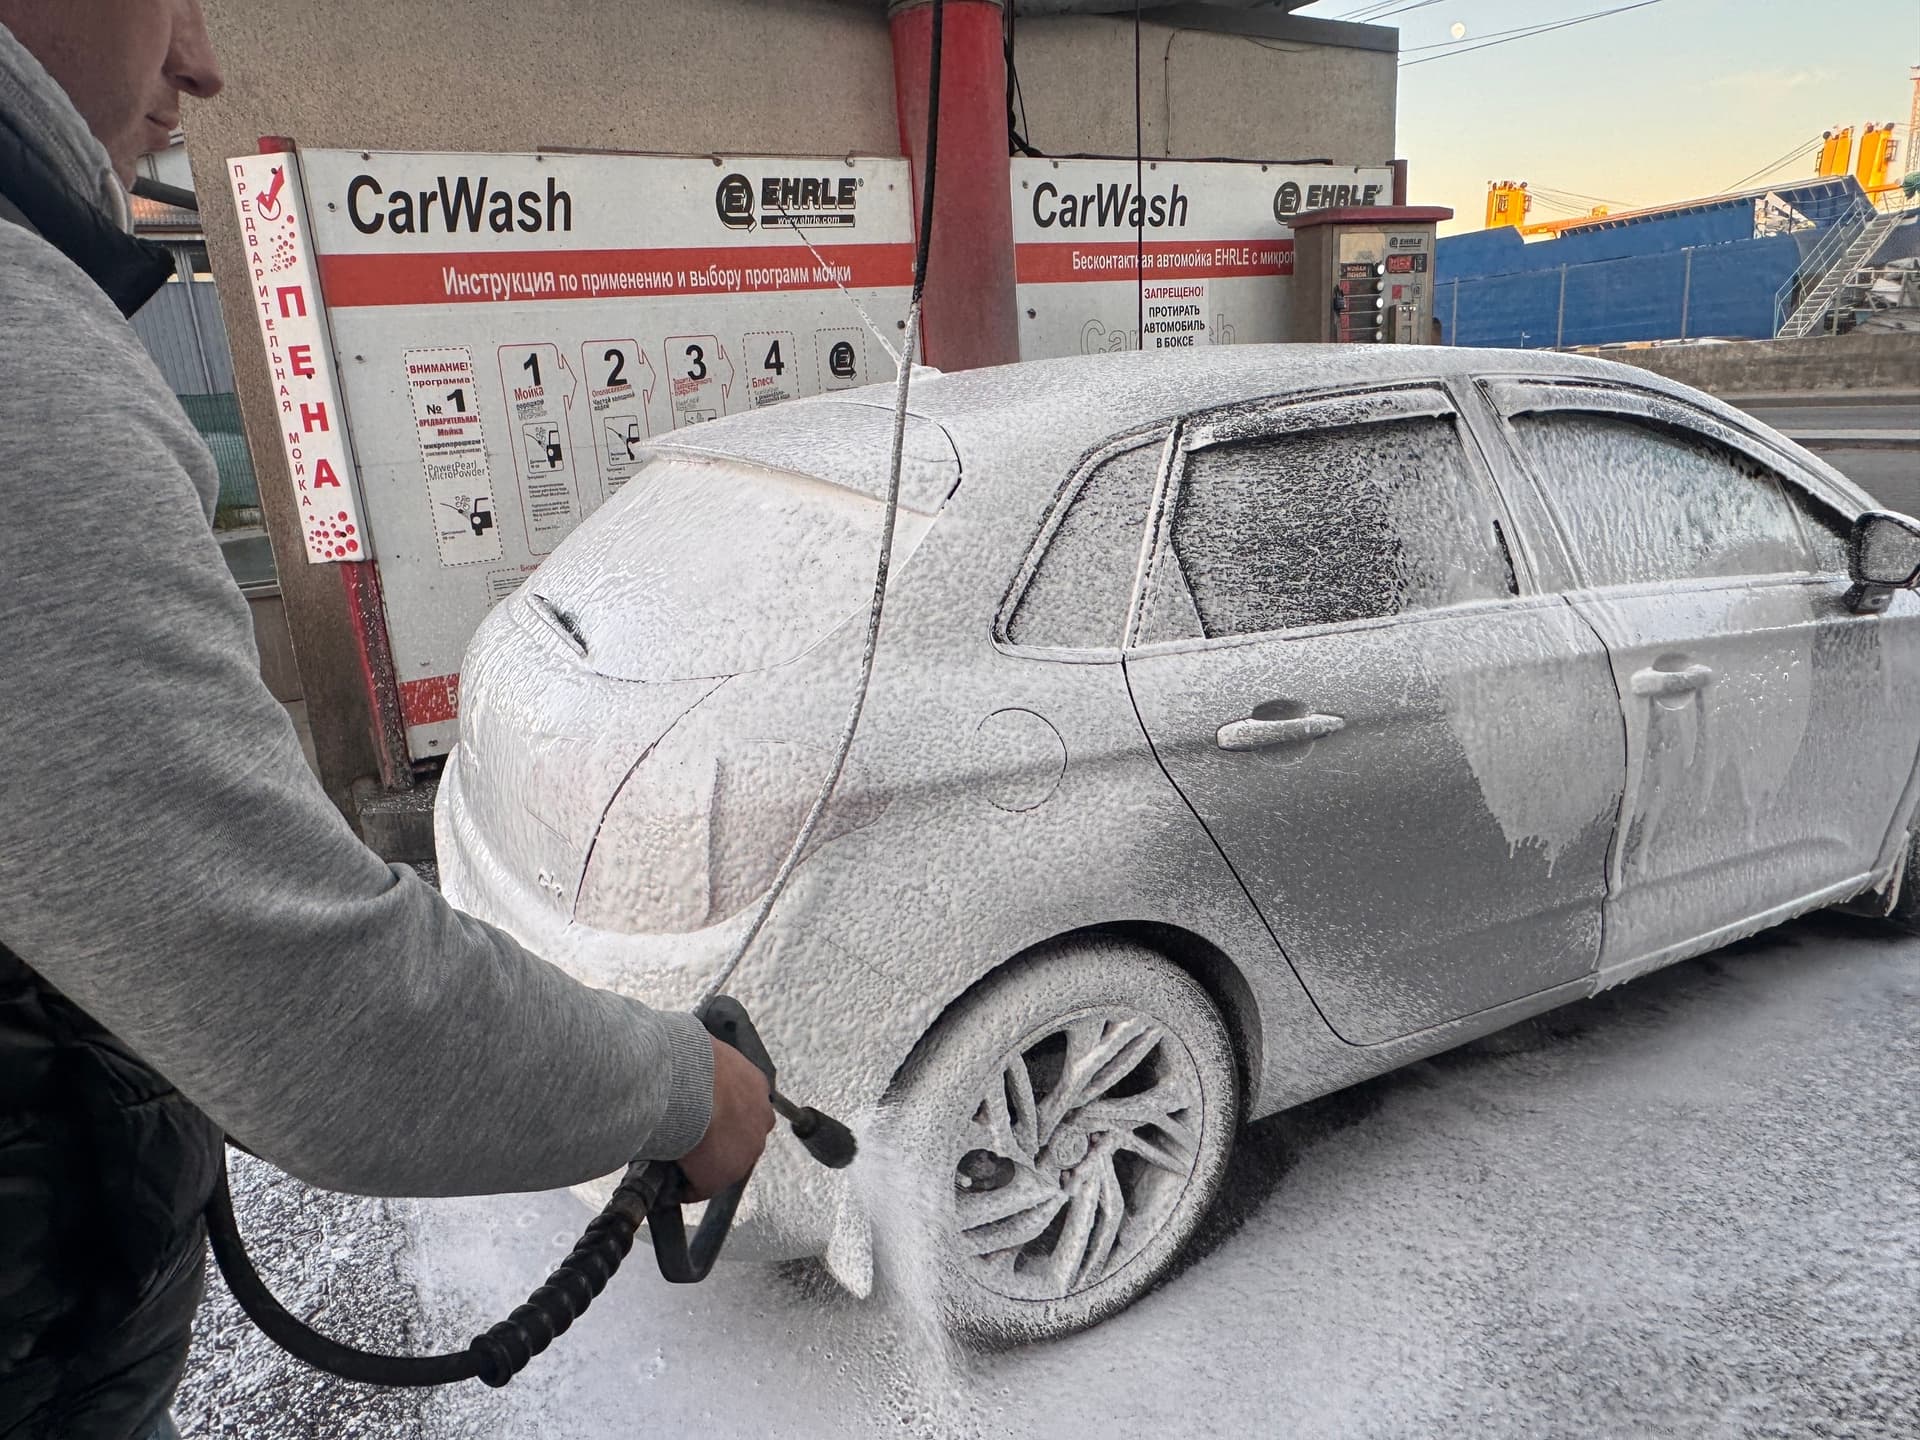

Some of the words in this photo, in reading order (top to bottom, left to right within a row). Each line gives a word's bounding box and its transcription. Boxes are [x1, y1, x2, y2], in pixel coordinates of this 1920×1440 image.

[347, 174, 571, 234] CarWash
[1033, 182, 1188, 228] CarWash
[777, 215, 840, 225] www.ehrle.com
[1156, 249, 1212, 267] автомойка
[1215, 248, 1249, 266] EHRLE
[1252, 252, 1258, 265] с
[442, 266, 555, 301] Инструкция
[559, 274, 578, 292] по
[581, 271, 673, 296] применению
[677, 270, 686, 287] и
[690, 264, 742, 291] выбору
[745, 267, 809, 289] программ
[812, 260, 851, 283] мойки
[1144, 286, 1204, 299] ЗАПРЕЩЕНО!
[1149, 304, 1200, 318] ПРОТИРАТЬ
[234, 164, 292, 412] ПРЕДВАРИТЕЛЬНАЯ
[289, 432, 312, 506] МОЙКА
[1144, 320, 1205, 334] АВТОМОБИЛЬ
[1156, 337, 1162, 348] В
[1164, 335, 1194, 347] БОКСЕ
[685, 344, 707, 380] 3
[764, 340, 785, 376] 4
[409, 362, 469, 374] ВНИМАНИЕ!
[523, 353, 541, 386] 1
[604, 349, 628, 386] 2
[276, 286, 341, 488] ПЕНА
[413, 377, 471, 388] программа
[752, 376, 774, 388] Блеск
[447, 389, 466, 412] 1
[514, 385, 544, 401] Мойка
[419, 415, 478, 427] ПРЕДВАРИТЕЛЬНАЯ
[427, 460, 477, 473] PowerPearl
[428, 468, 485, 481] MicroPowder
